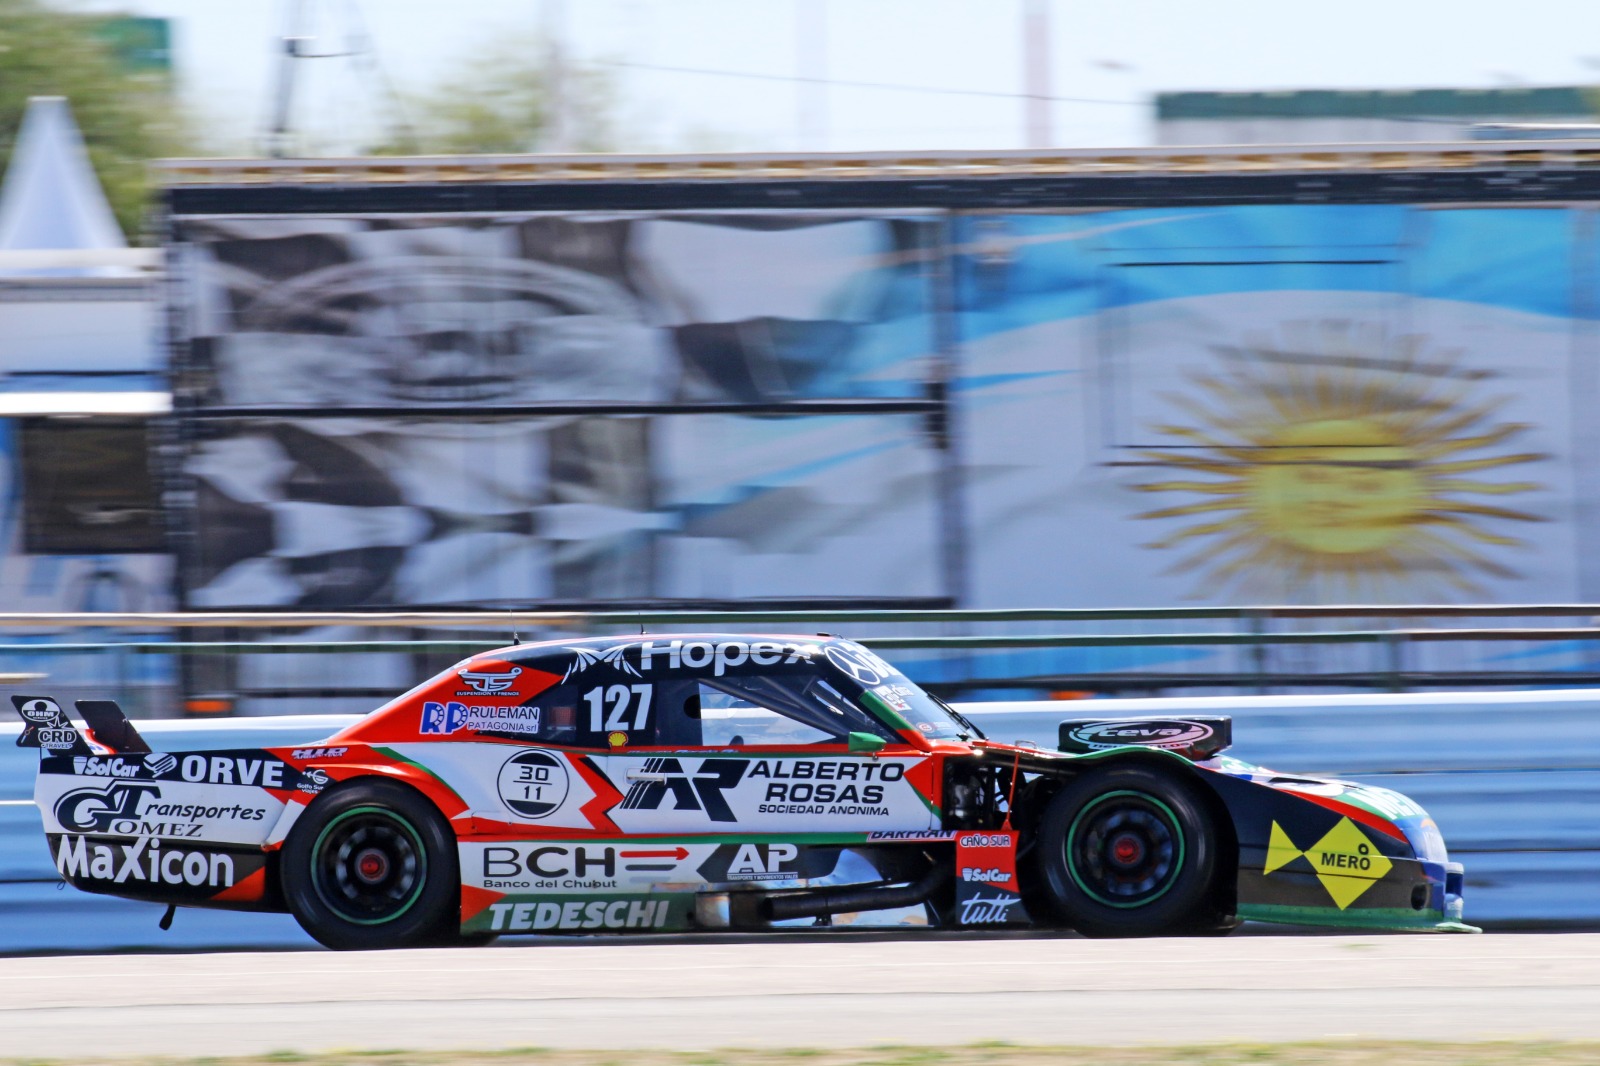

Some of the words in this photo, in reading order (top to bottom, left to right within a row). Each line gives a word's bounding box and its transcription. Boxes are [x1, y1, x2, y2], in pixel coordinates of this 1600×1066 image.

[640, 640, 822, 677] Hopex
[469, 706, 539, 720] RULEMAN
[583, 683, 653, 733] 127
[39, 729, 76, 744] CRD
[467, 721, 525, 731] PATAGONIA
[85, 756, 140, 777] SolCar
[181, 754, 285, 787] ORVE
[519, 765, 549, 781] 30
[747, 760, 905, 782] ALBERTO
[524, 785, 541, 800] 11
[765, 783, 884, 804] ROSAS
[758, 804, 824, 814] SOCIEDAD
[828, 806, 889, 816] ANONIMA
[960, 834, 989, 847] CAÑO
[483, 846, 615, 878] BCH
[727, 843, 798, 873] AP
[483, 879, 530, 888] Banco
[534, 879, 558, 888] del
[562, 879, 617, 888] Chubut
[971, 868, 1012, 882] SolCar
[488, 900, 670, 930] TEDESCHI
[960, 892, 1022, 925] tutti
